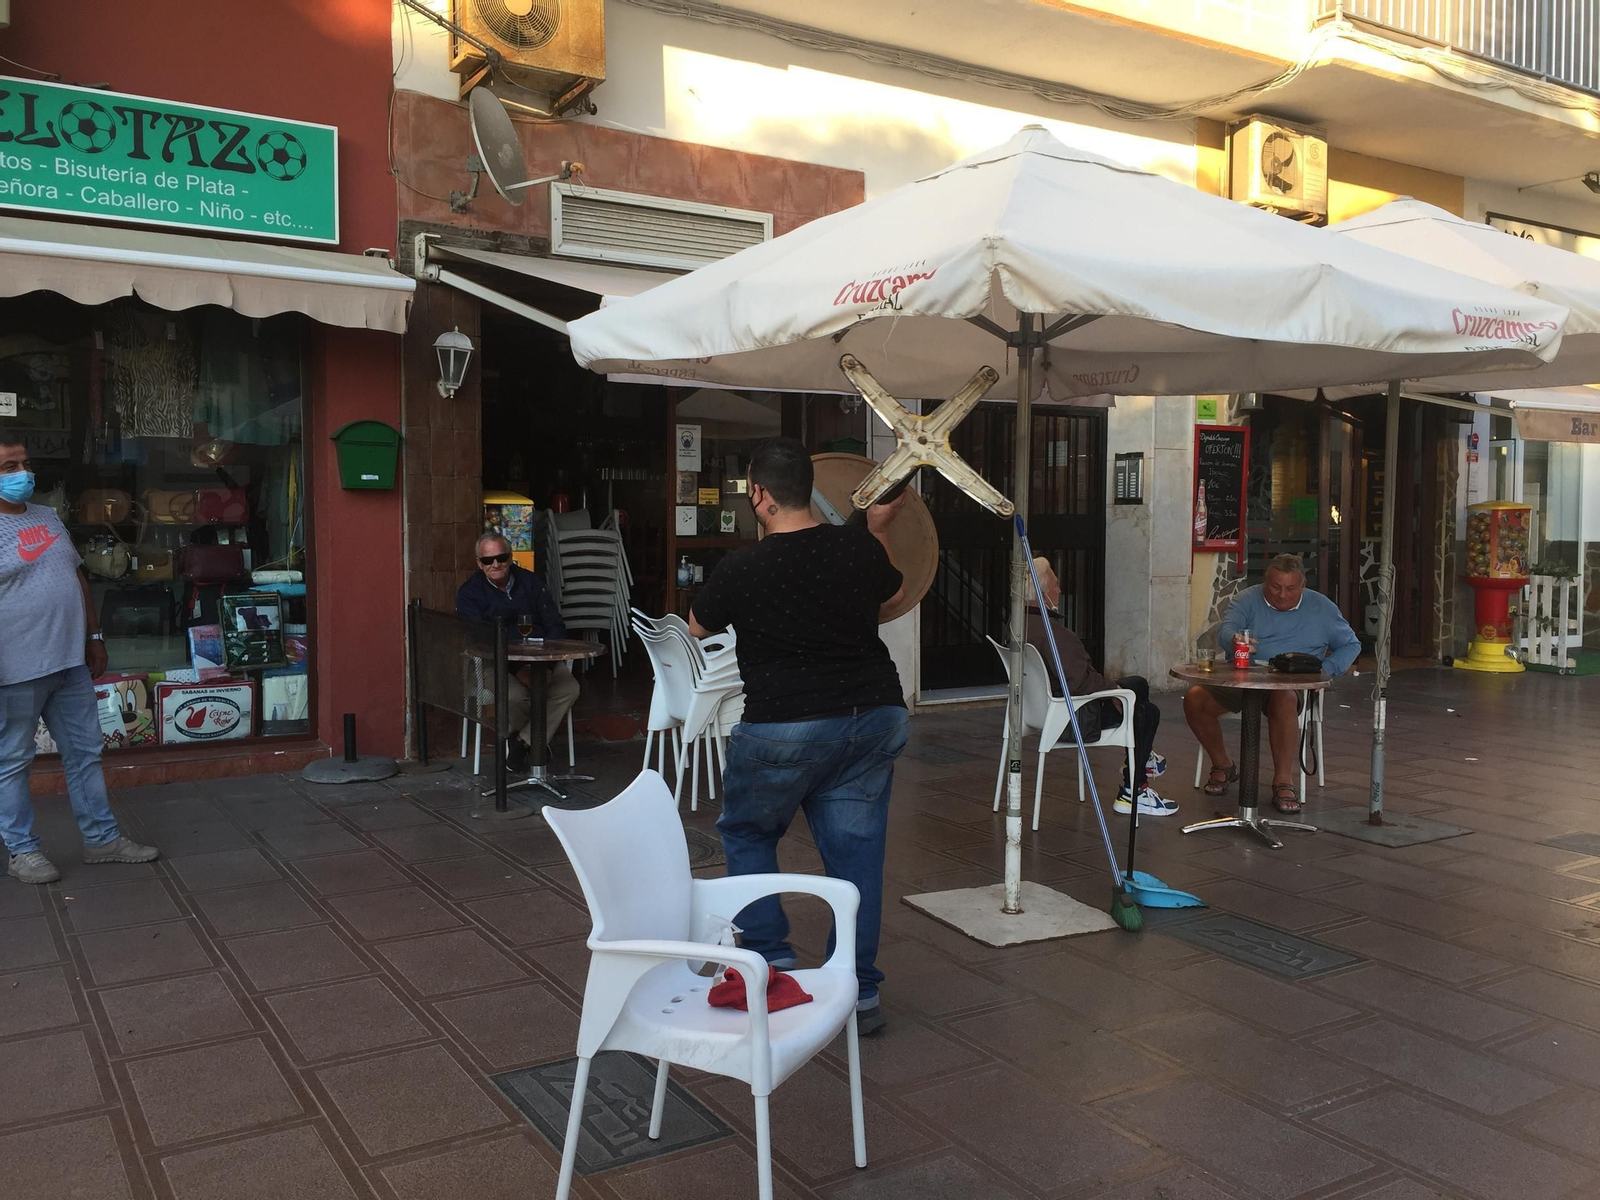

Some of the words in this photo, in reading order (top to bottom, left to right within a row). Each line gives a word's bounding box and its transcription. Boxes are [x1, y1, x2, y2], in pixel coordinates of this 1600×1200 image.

[0, 151, 32, 171] tos
[55, 157, 147, 186] Bisutería
[154, 171, 179, 188] de
[186, 174, 235, 196] Plata
[0, 178, 58, 199] eñora
[80, 186, 179, 213] Caballero
[200, 200, 244, 221] Niño
[263, 210, 314, 229] etc....
[833, 267, 938, 306] Cruzcam
[1571, 417, 1598, 436] Bar
[18, 524, 51, 547] NIKE
